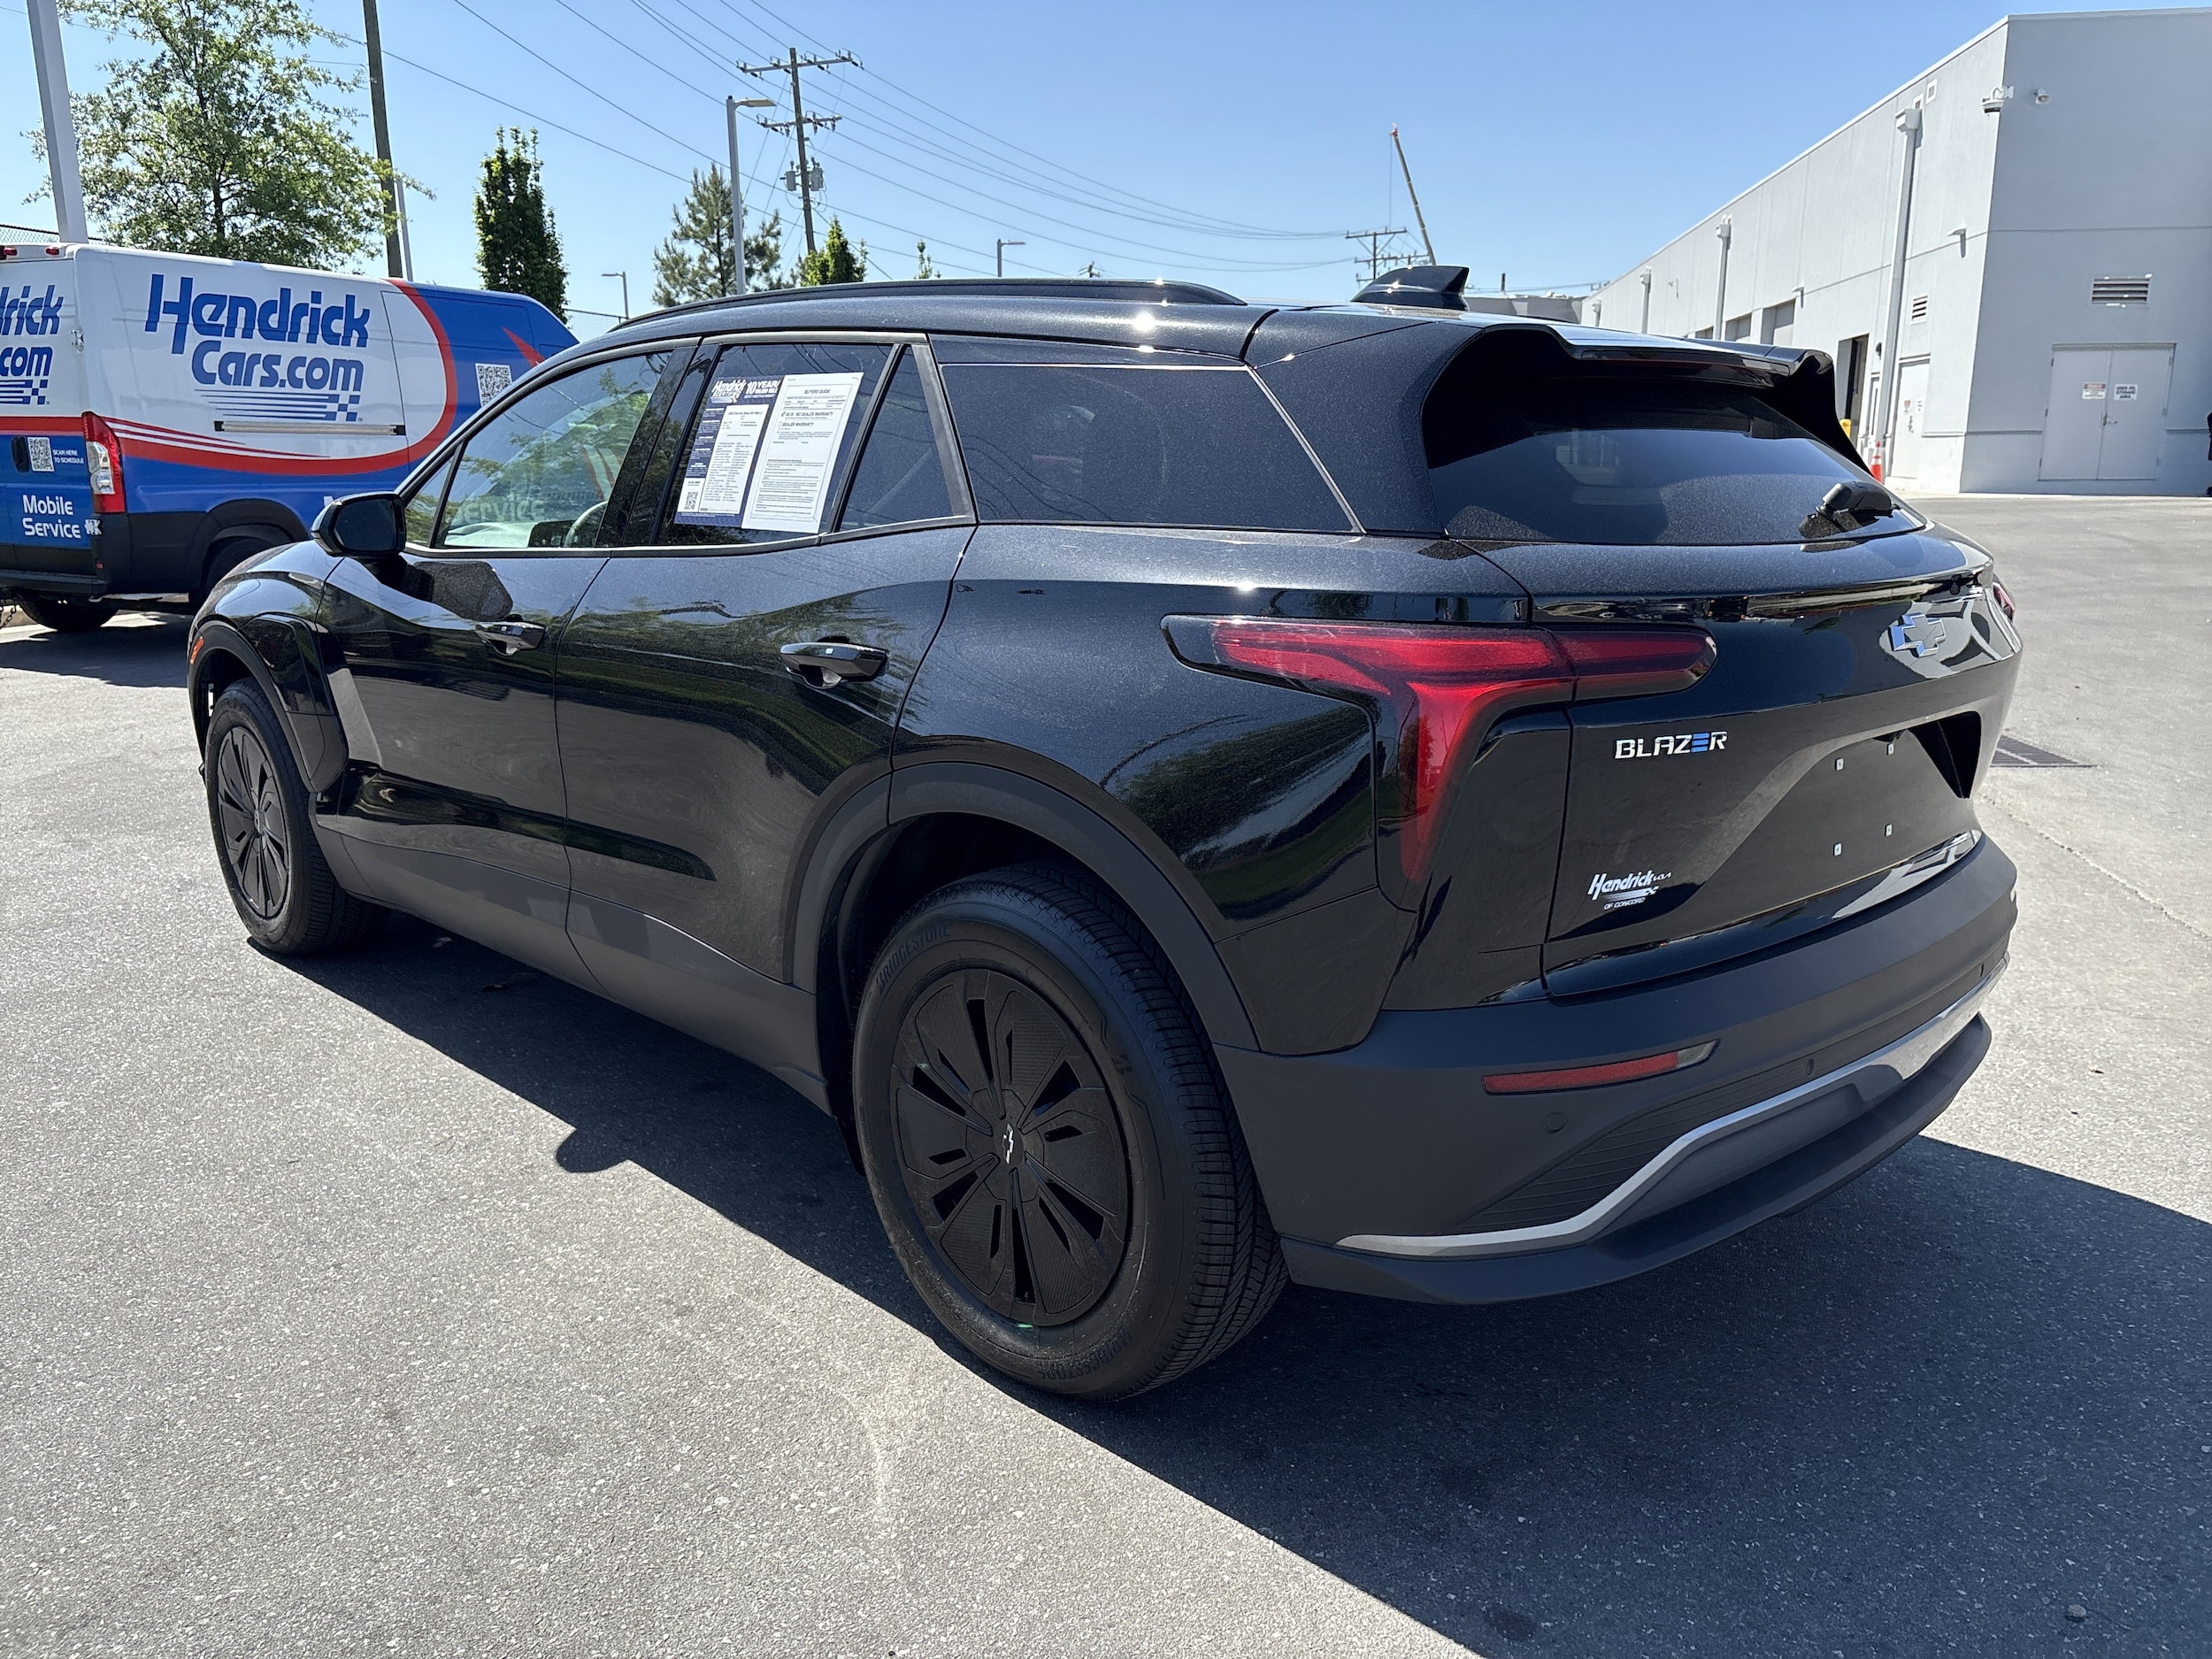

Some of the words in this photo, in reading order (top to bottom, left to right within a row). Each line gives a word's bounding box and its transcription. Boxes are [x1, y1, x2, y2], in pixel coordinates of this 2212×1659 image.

[145, 273, 370, 354] Hendrick
[192, 340, 364, 391] Cars.com
[22, 495, 74, 515] Mobile
[22, 518, 81, 539] Service
[1615, 731, 1727, 759] BLAZER
[1587, 870, 1655, 901] Hendrick
[1613, 897, 1646, 909] CONCORD
